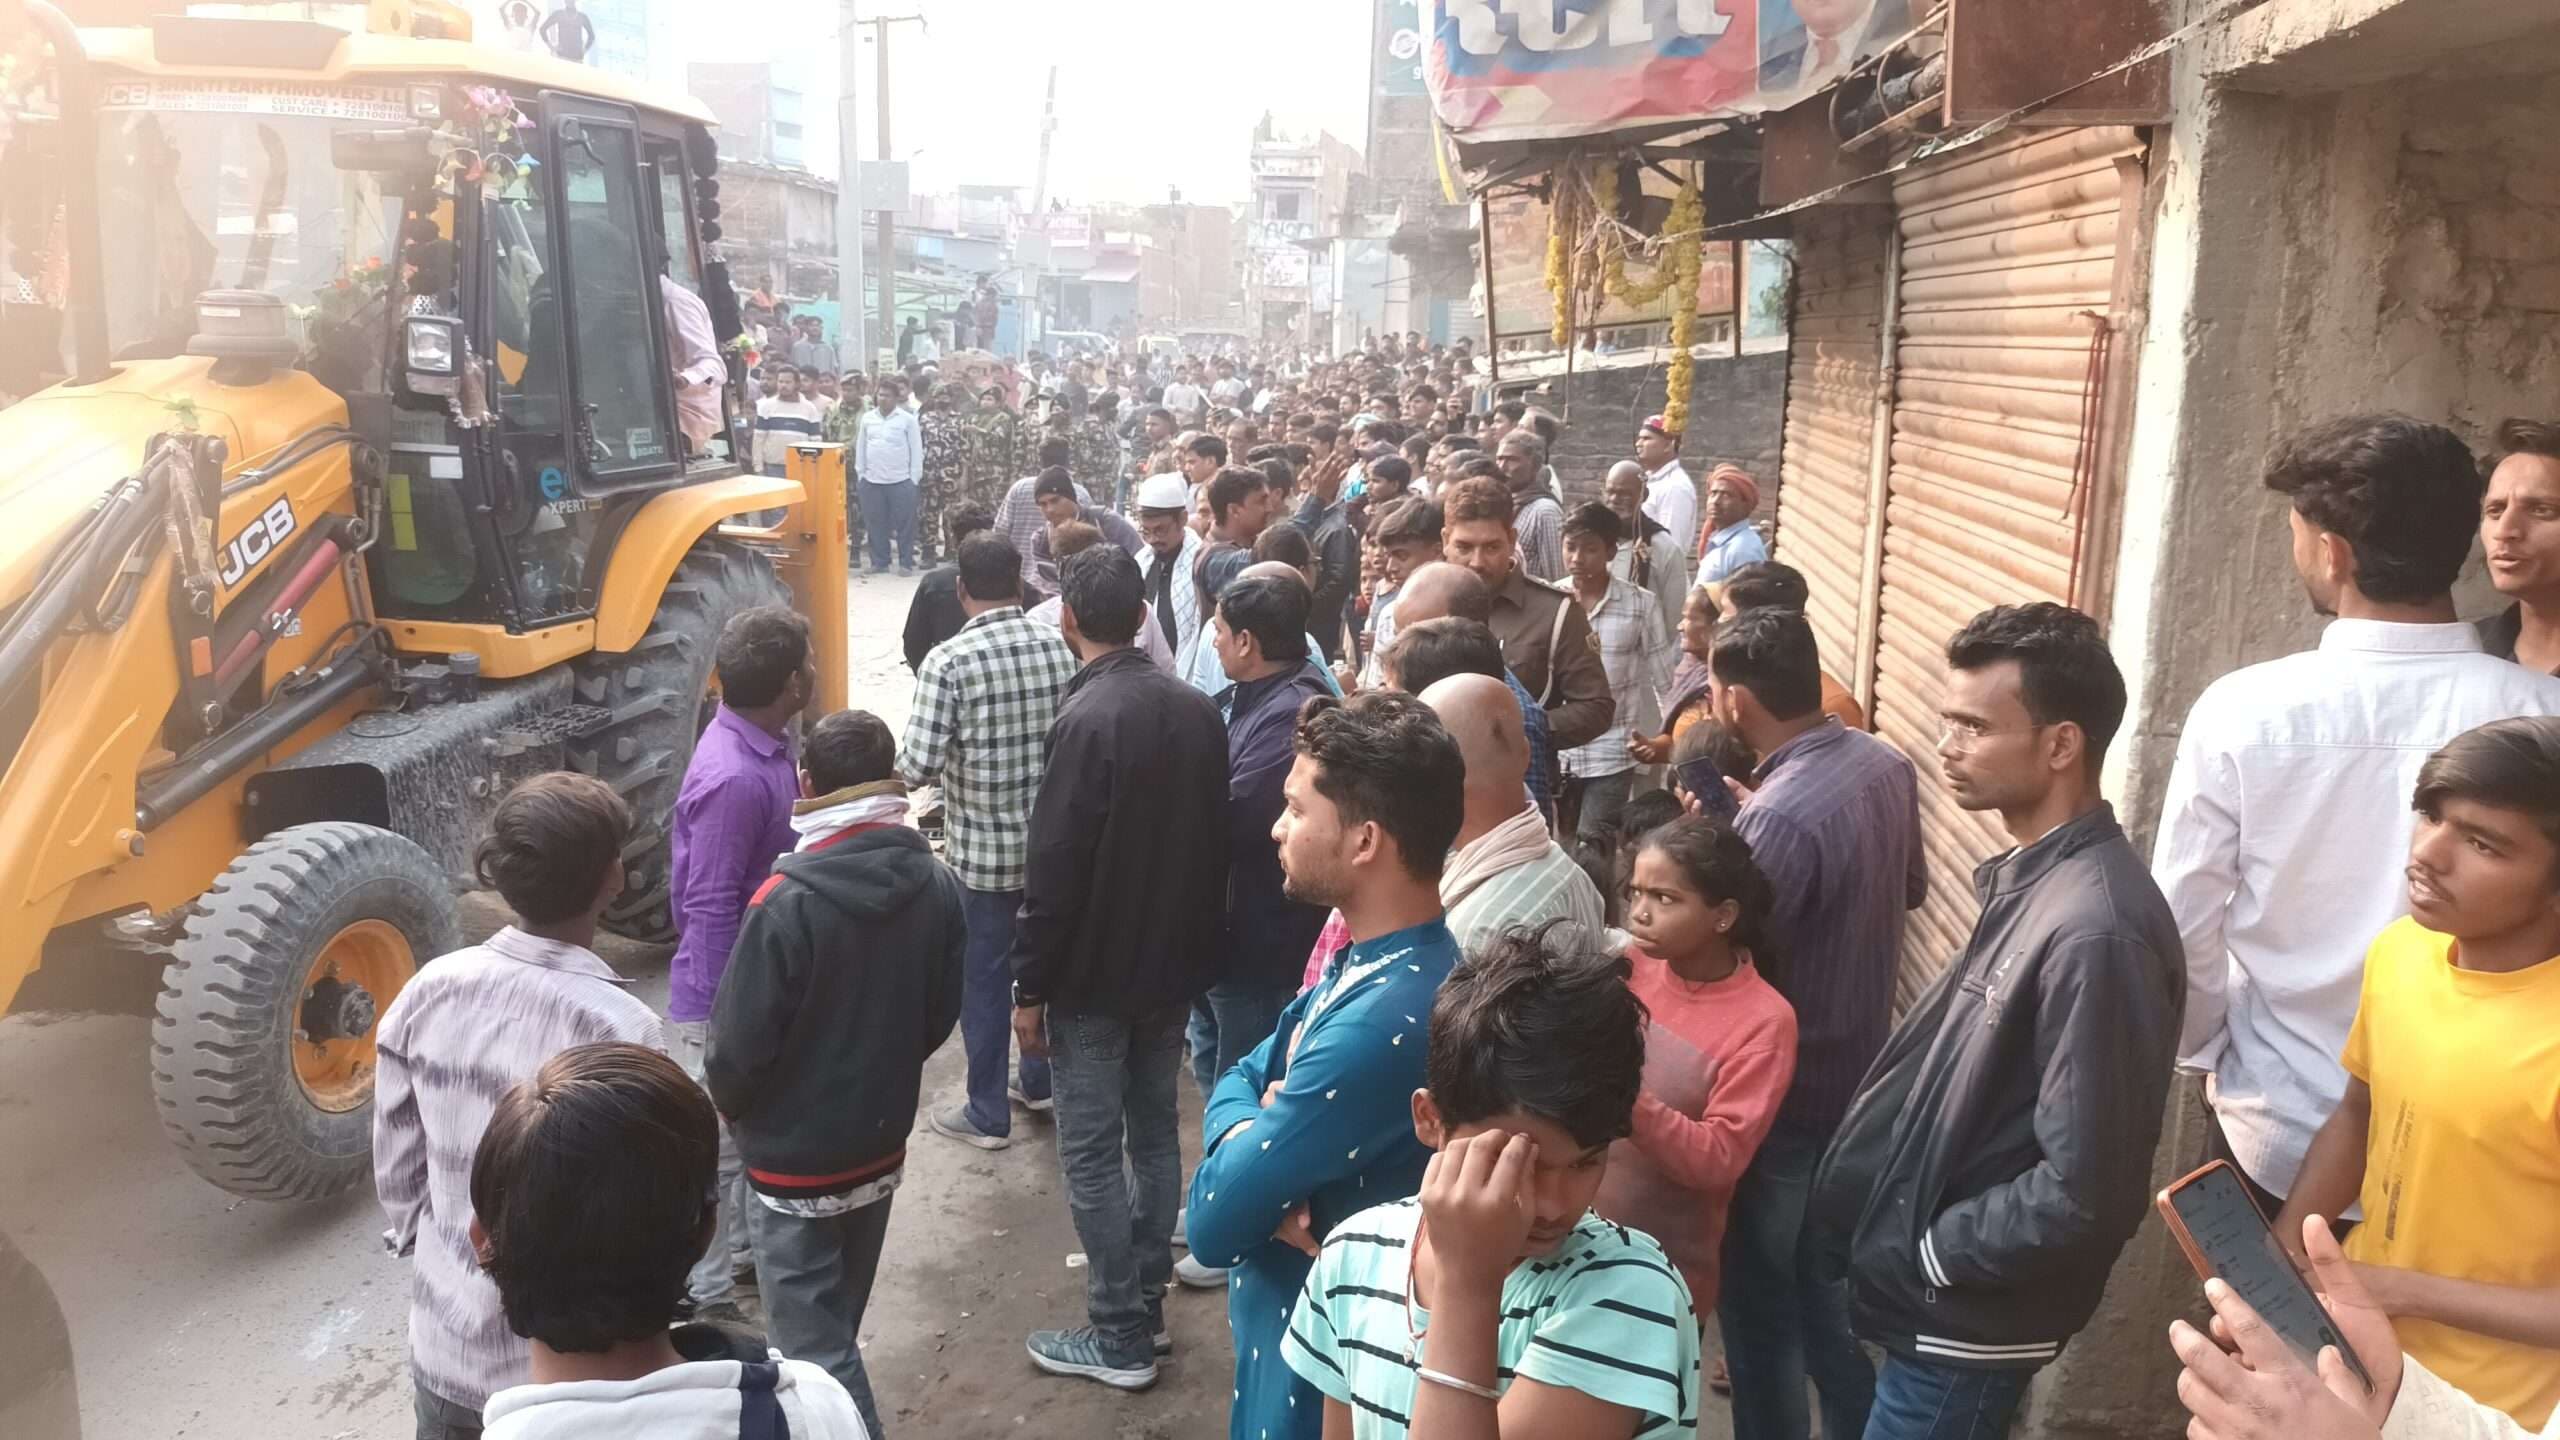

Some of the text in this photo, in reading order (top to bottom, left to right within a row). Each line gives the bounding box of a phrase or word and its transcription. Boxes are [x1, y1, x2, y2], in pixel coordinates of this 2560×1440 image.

[157, 80, 223, 93] SHAKTI
[228, 80, 376, 100] EARTHMOVERS
[271, 104, 329, 115] SERVICE
[549, 499, 588, 515] XPERT
[222, 499, 295, 585] JCB
